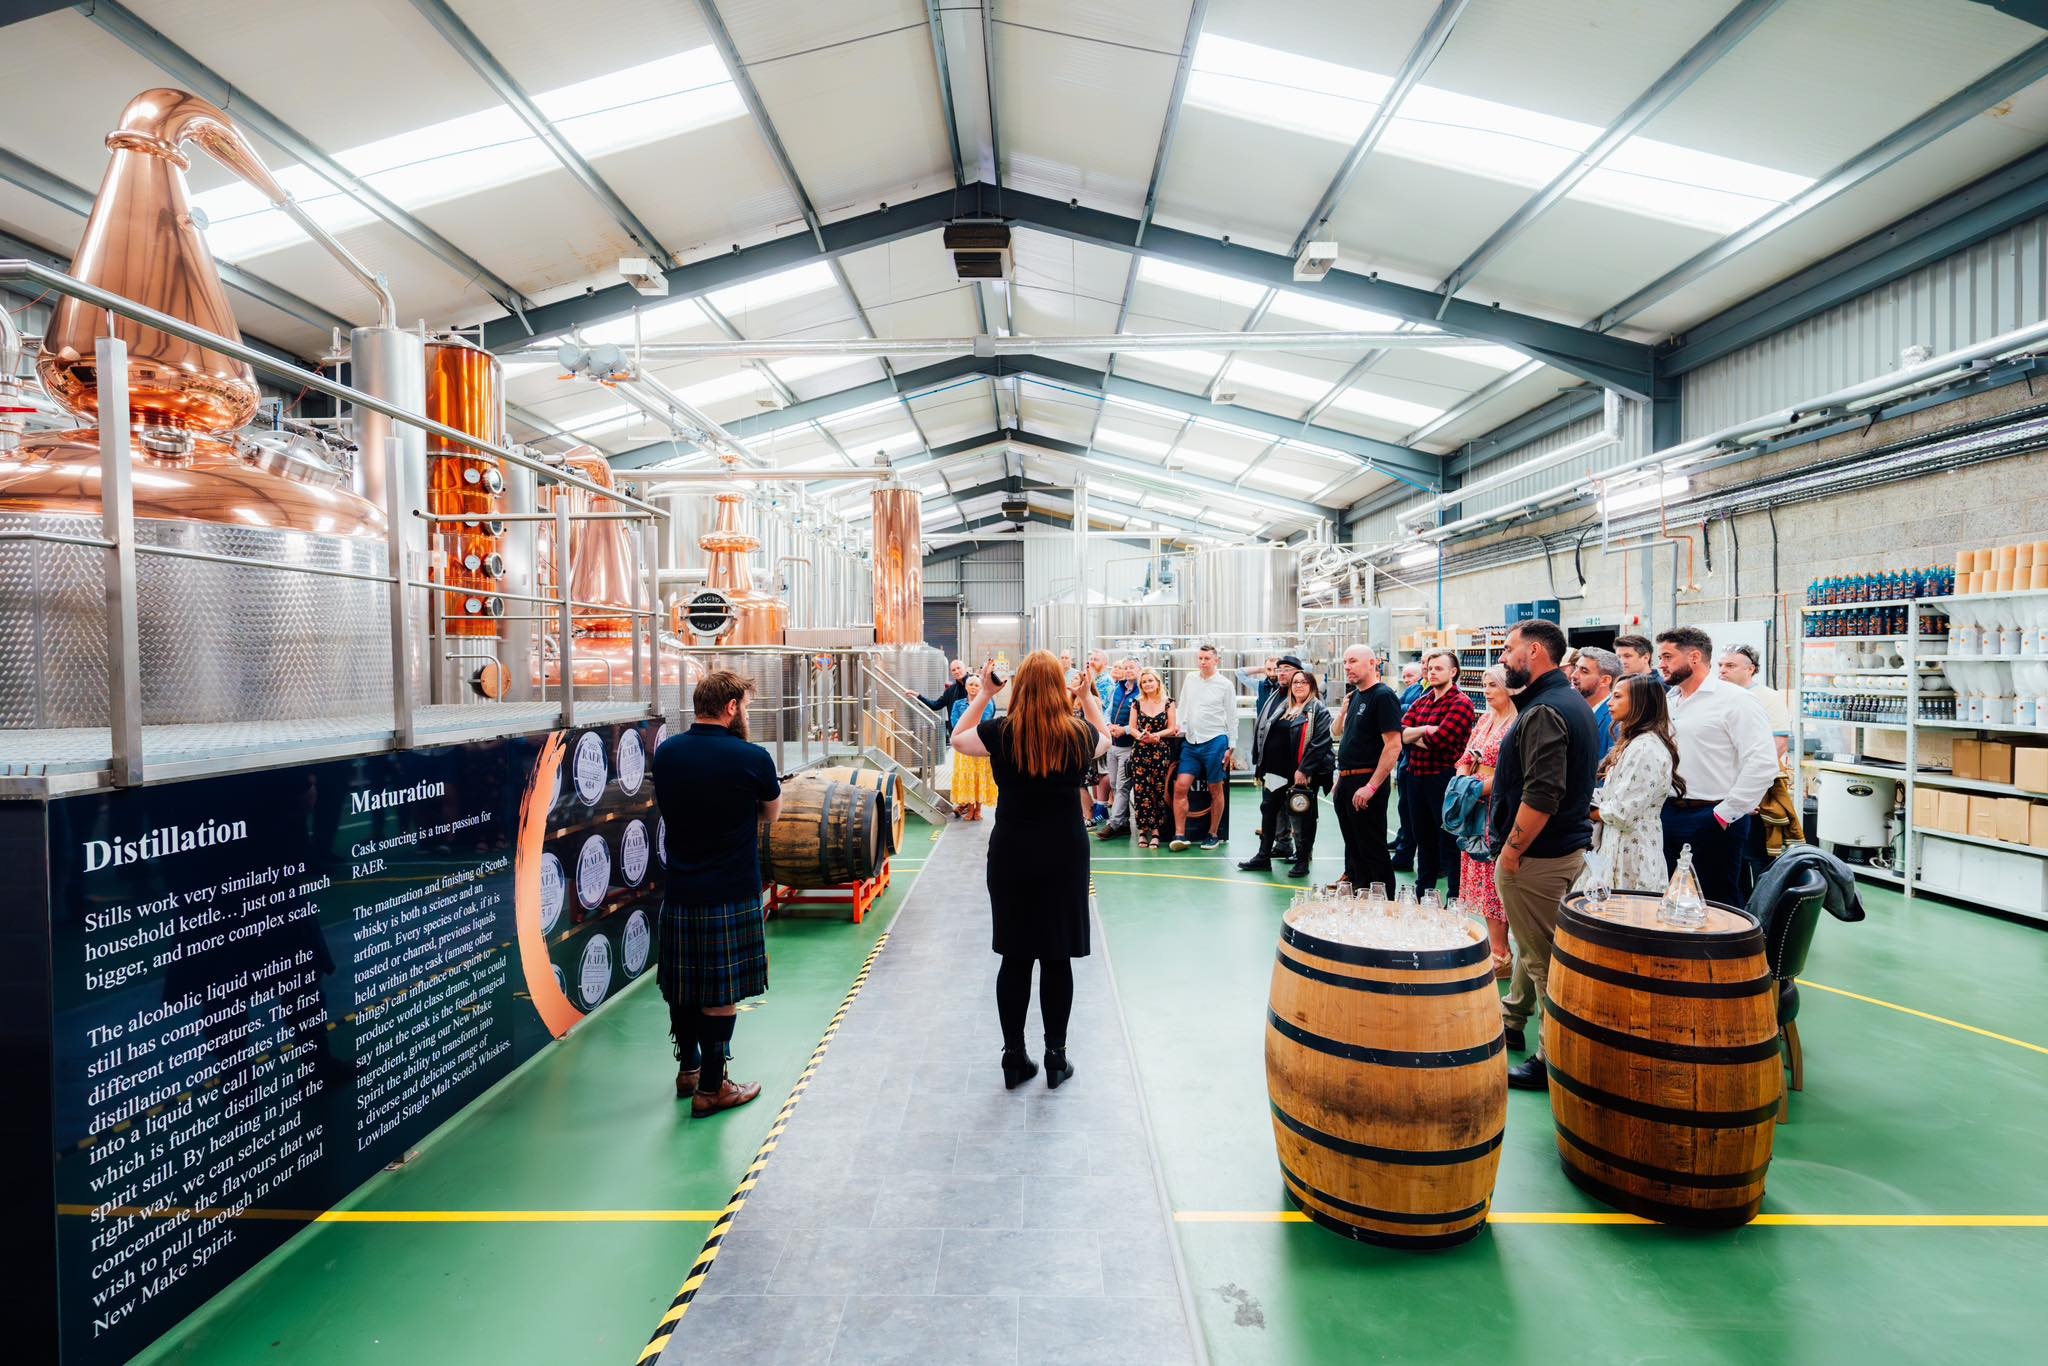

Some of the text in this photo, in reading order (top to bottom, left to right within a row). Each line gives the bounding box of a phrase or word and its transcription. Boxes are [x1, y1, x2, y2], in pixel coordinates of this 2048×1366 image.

[351, 779, 444, 814] Maturation
[352, 811, 491, 857] Cask sourcing true passion for
[84, 819, 247, 872] Distillation
[353, 859, 387, 879] RAER.
[353, 856, 507, 920] The maturation and finishing Scotch
[86, 865, 295, 932] Stills work very similarly to
[86, 919, 174, 961] household
[241, 895, 266, 917] just
[270, 891, 285, 904] on
[299, 875, 330, 895] much
[354, 885, 473, 941] whisky both science and
[354, 902, 479, 963] artform. Every species oak,
[86, 902, 320, 990] bigger, and more complex scale.
[355, 911, 496, 984] toasted charred, previous liquids
[355, 932, 493, 1005] held within the cask (among other
[356, 952, 483, 1025] things) can influence our spirit
[87, 950, 313, 1047] The alcoholic liquid within the
[89, 970, 315, 1078] still has compounds that boil at
[356, 956, 506, 1050] produce world class drams. You could
[357, 973, 505, 1068] say that the cask fourth magical
[89, 991, 319, 1106] different temperatures. The first
[89, 1008, 328, 1135] distillation concentrates the wash
[357, 1001, 492, 1088] ingredient, giving our New Make
[358, 1017, 493, 1109] Spirit ability transform into
[366, 1044, 478, 1124] diverse delicious range
[90, 1040, 317, 1165] into liquid we call low wines,
[90, 1062, 315, 1191] which further distilled in the
[359, 1040, 511, 1151] Lowland Single Malt Scotch Whiskies.
[92, 1080, 323, 1223] spirit still. By heating in just the
[92, 1111, 300, 1251] right way, we can select and
[92, 1125, 322, 1279] concentrate the flavours that we
[93, 1143, 322, 1306] wish to pull through in our final
[94, 1230, 236, 1338] New Make Spirit.
